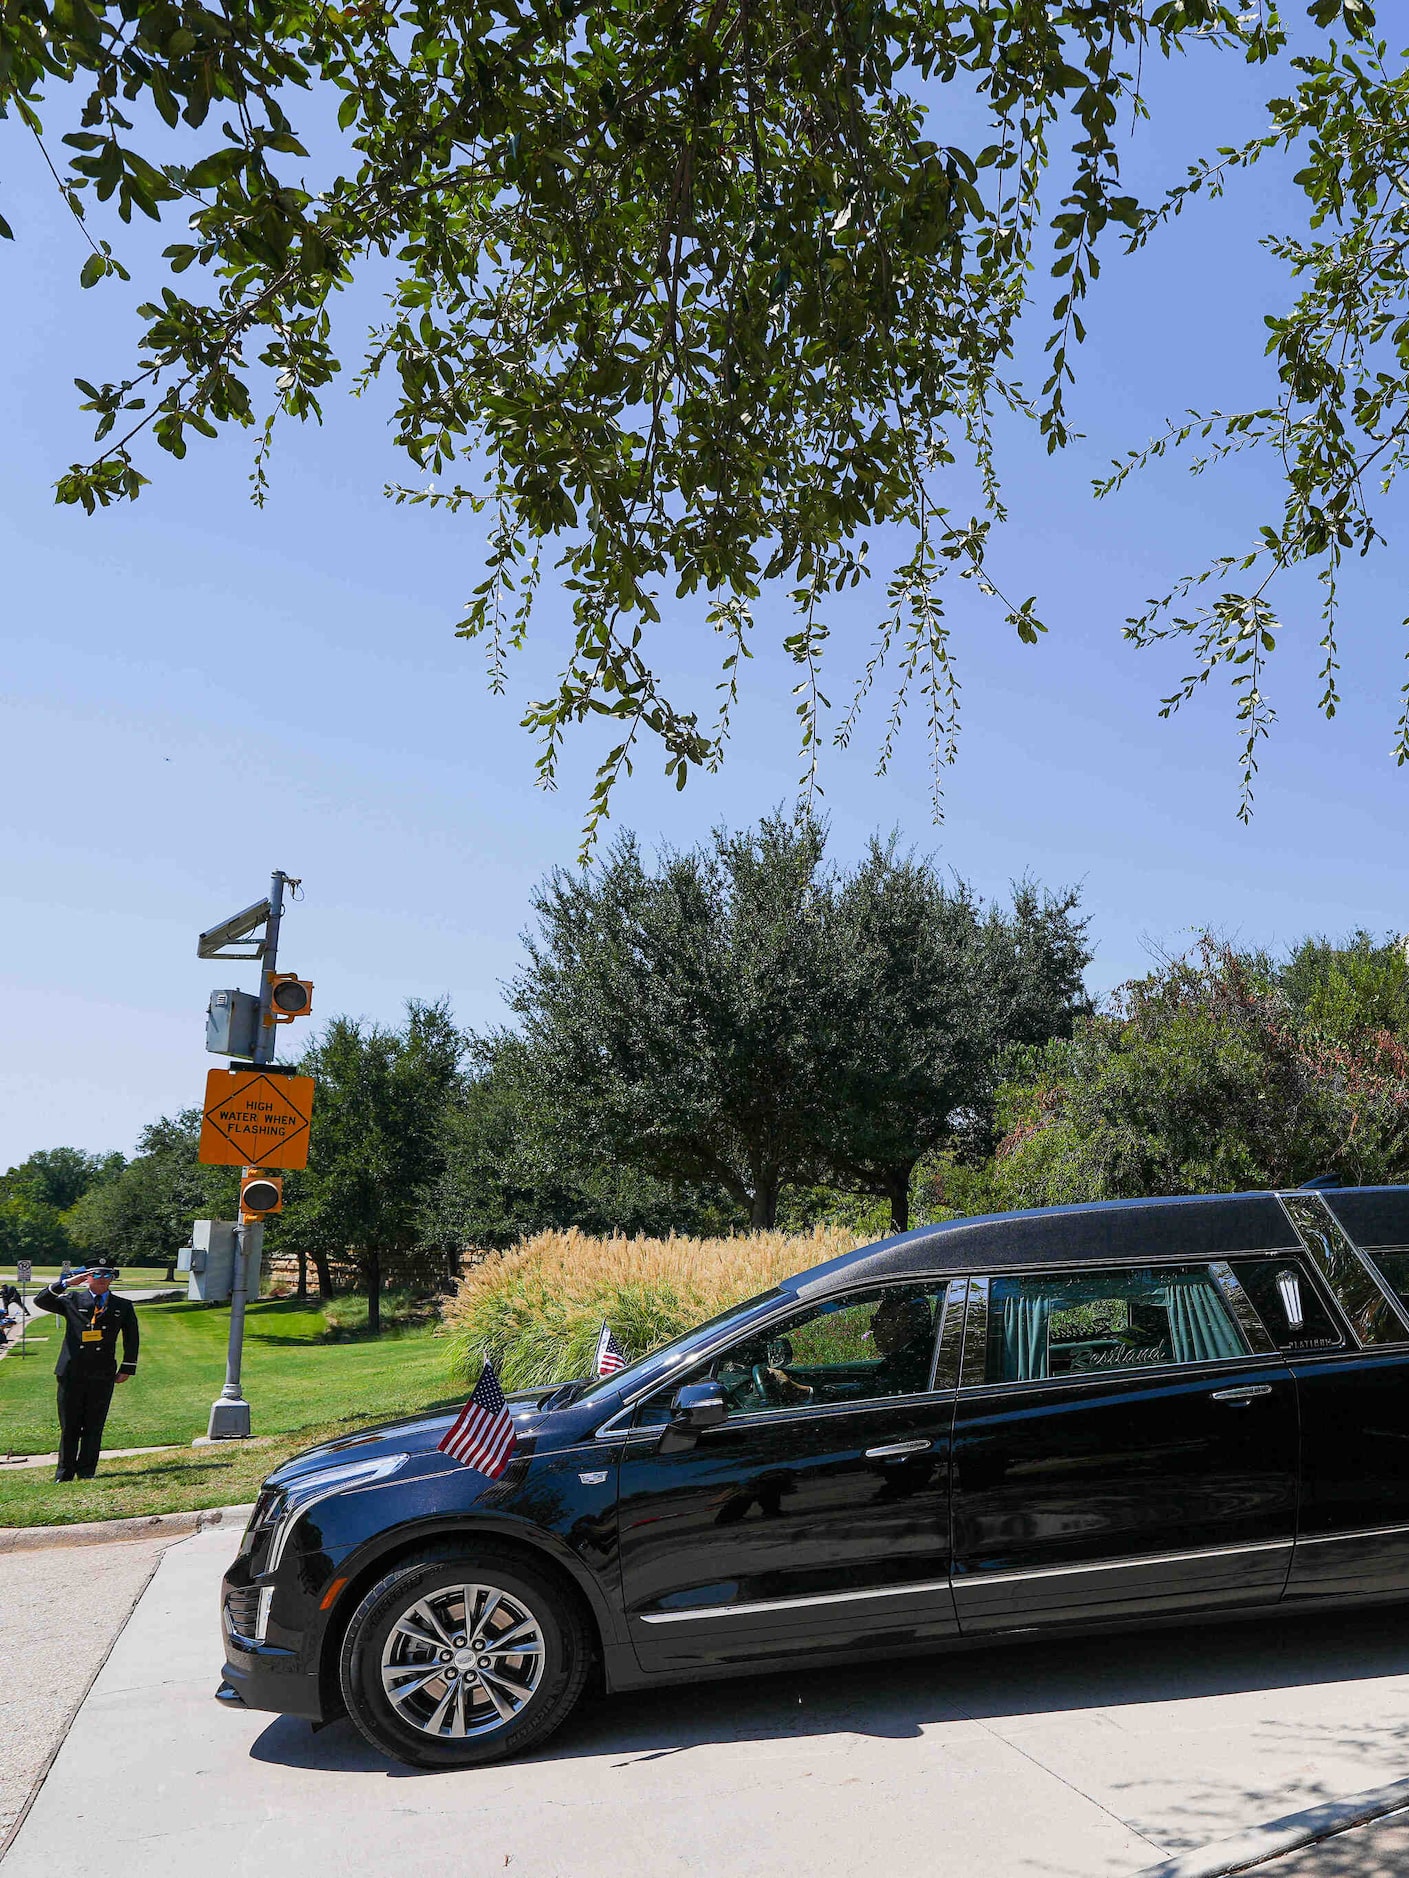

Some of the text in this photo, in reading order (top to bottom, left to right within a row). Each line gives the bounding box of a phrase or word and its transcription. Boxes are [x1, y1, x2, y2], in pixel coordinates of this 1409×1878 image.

[246, 1101, 273, 1112] HIGH
[220, 1111, 296, 1125] WATER WHEN
[228, 1123, 285, 1136] FLASHING
